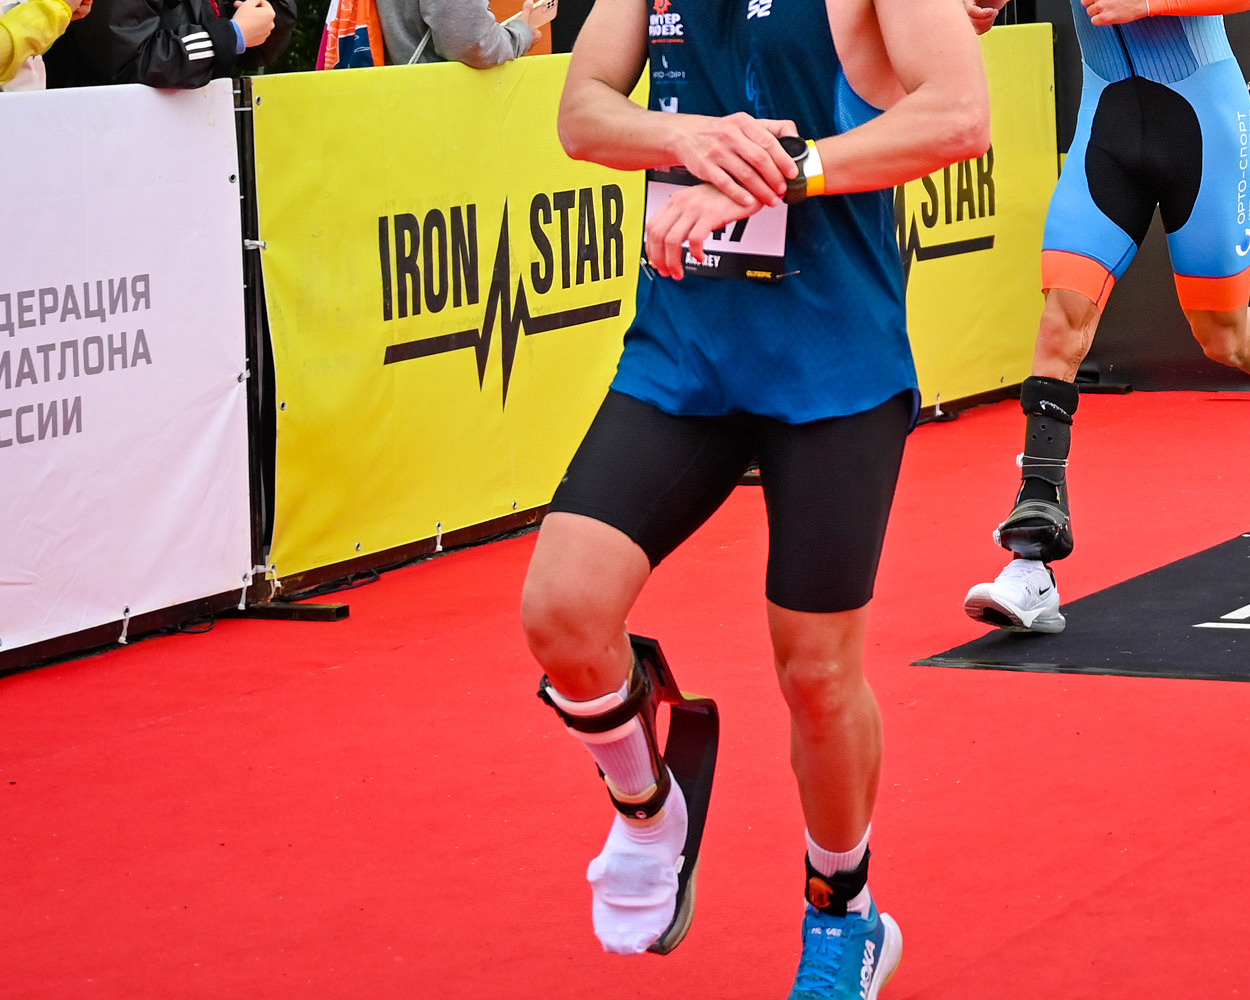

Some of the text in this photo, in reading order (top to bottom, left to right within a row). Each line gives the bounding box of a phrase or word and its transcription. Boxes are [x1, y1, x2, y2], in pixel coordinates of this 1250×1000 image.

[1237, 110, 1249, 225] ОРТО-СПОРТ
[378, 184, 625, 322] IRON STAR
